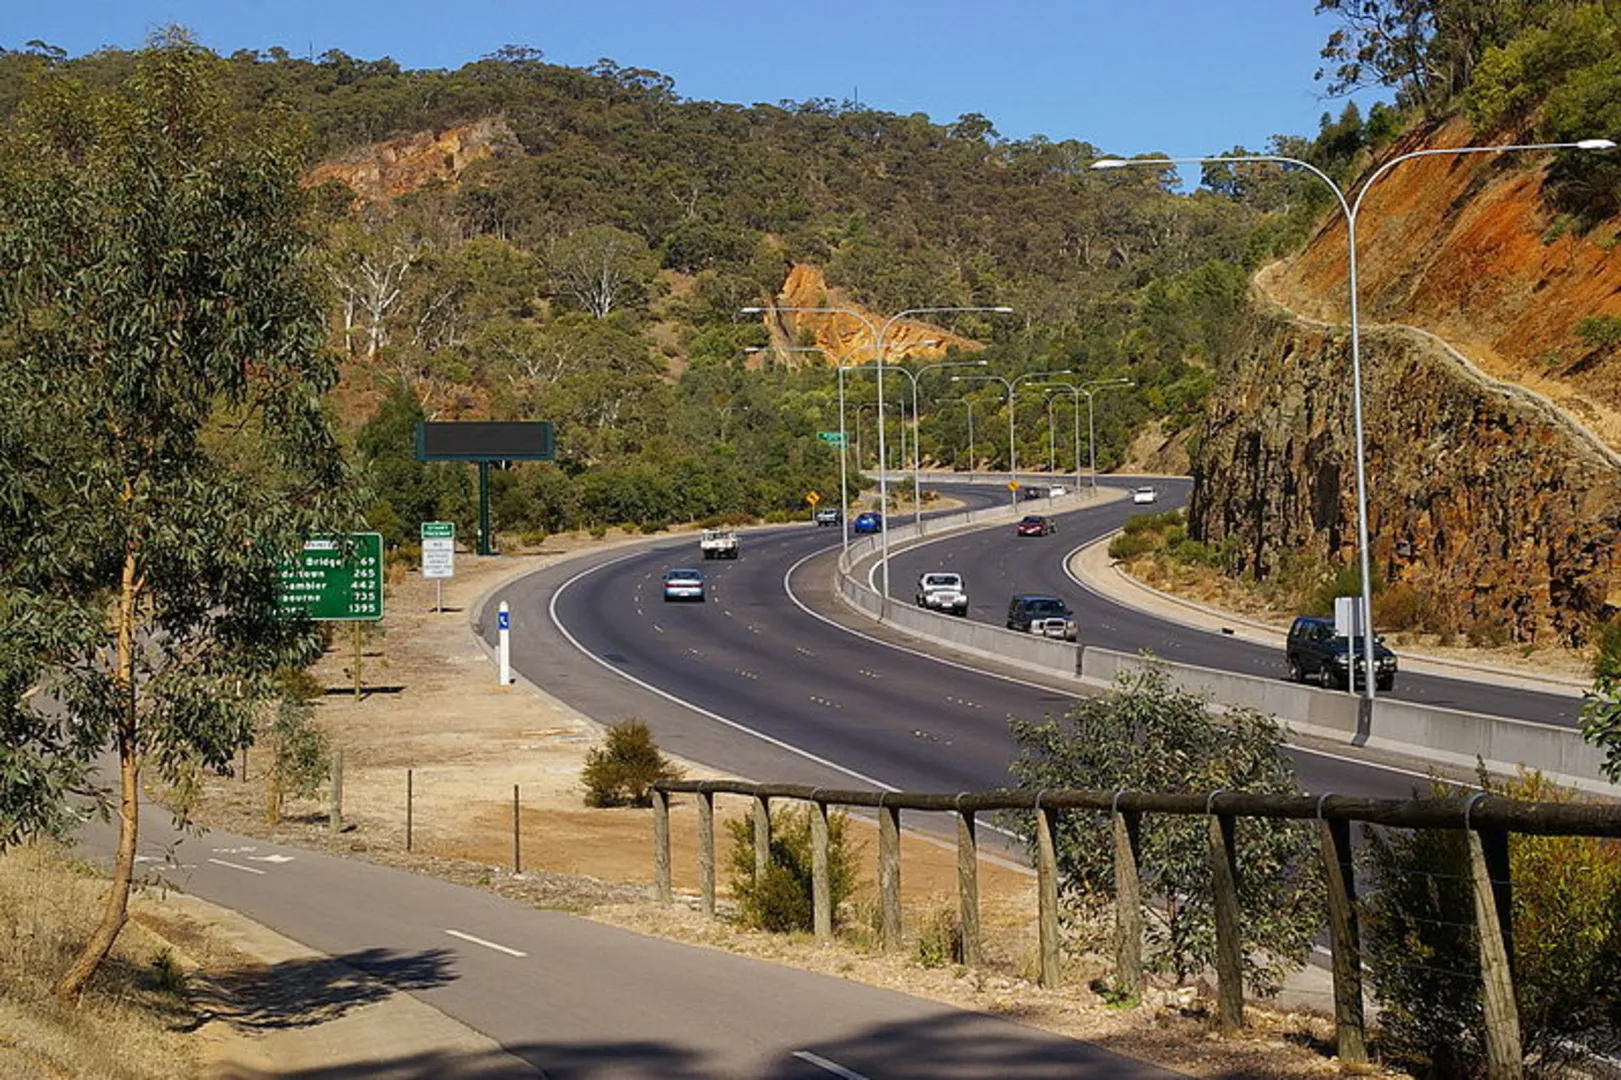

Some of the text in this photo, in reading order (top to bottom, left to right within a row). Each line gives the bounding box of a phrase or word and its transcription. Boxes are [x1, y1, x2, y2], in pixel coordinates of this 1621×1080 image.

[305, 557, 342, 568] Bridge
[359, 556, 376, 566] 69
[353, 568, 376, 578] 265
[350, 580, 376, 589] 442
[353, 591, 376, 601] 735
[348, 603, 376, 612] 1395
